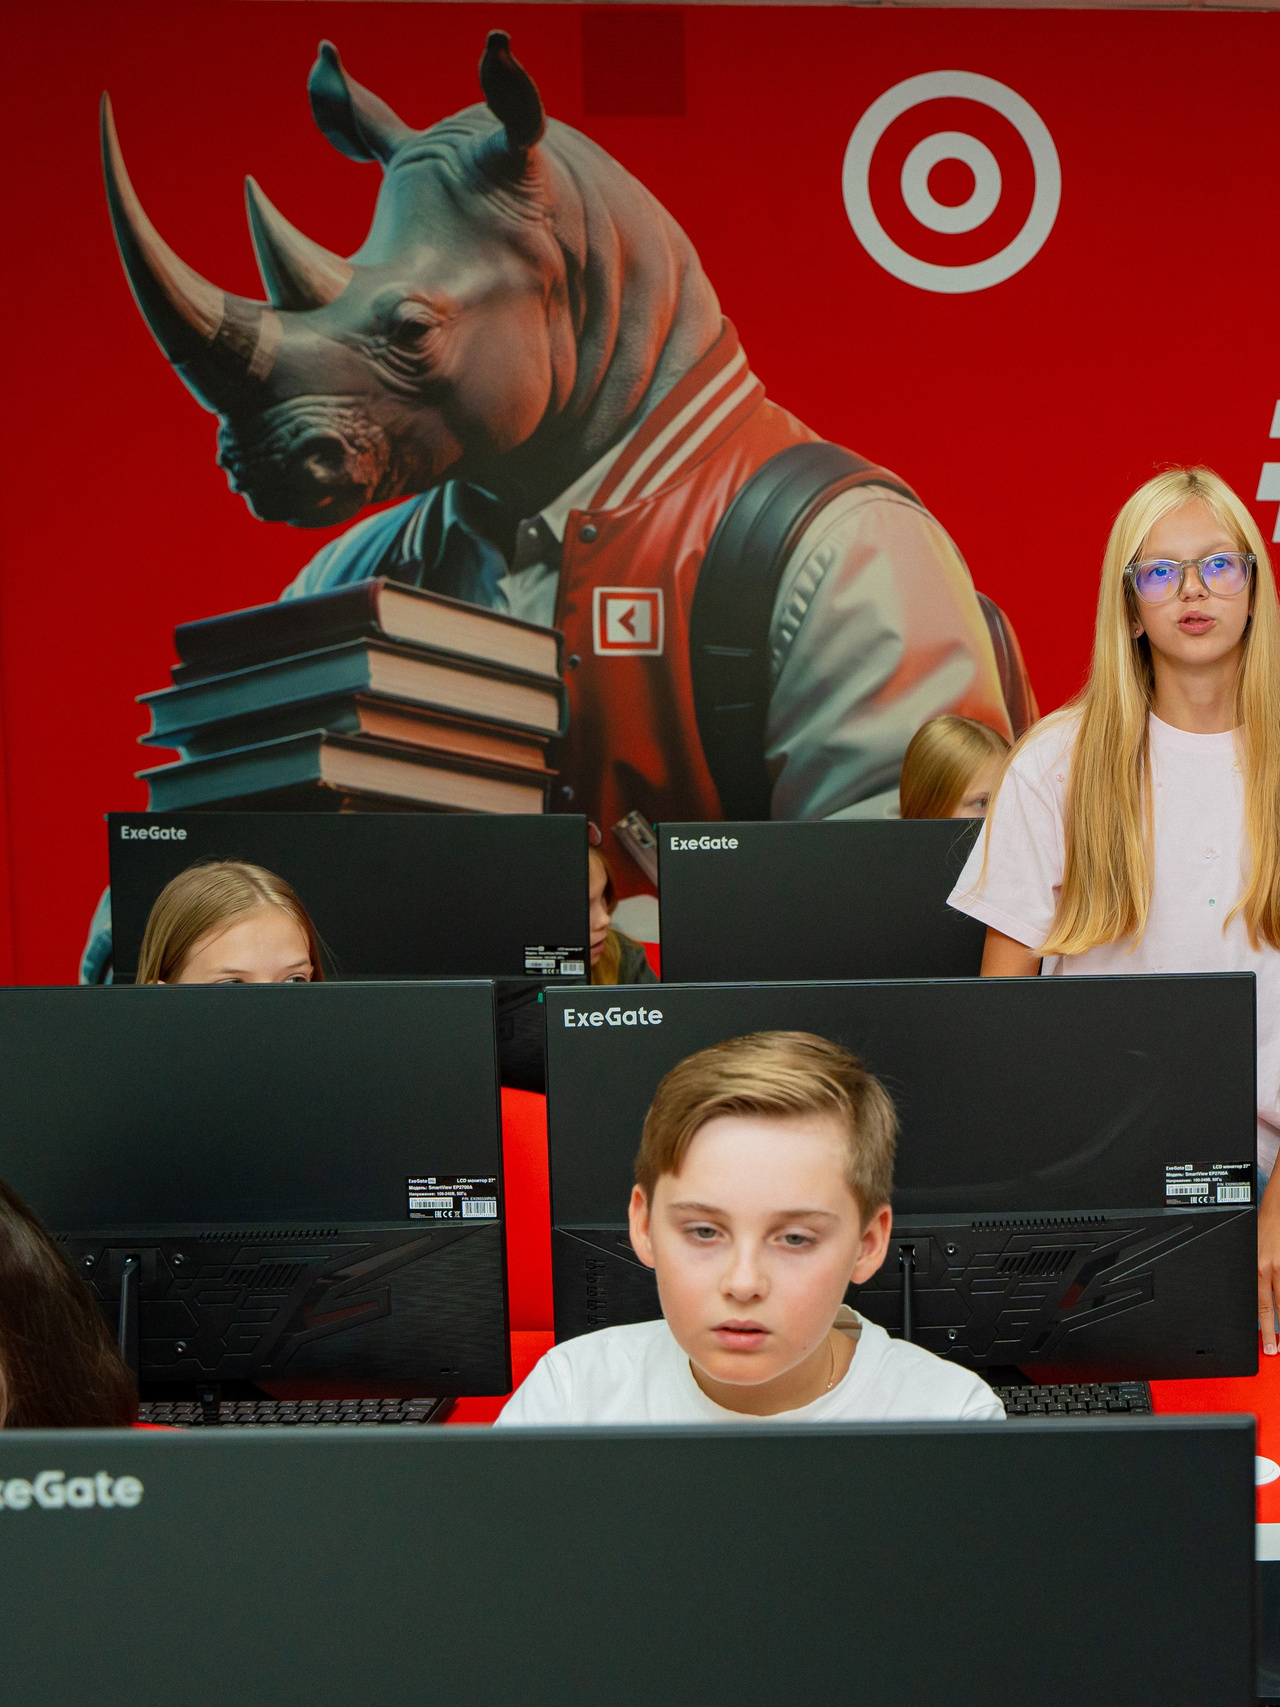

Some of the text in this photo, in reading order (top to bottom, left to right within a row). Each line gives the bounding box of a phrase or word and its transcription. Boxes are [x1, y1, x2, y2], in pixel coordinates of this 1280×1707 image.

[120, 825, 188, 841] ExeGate
[669, 835, 740, 852] ExeGate
[563, 1006, 664, 1029] ExeGate
